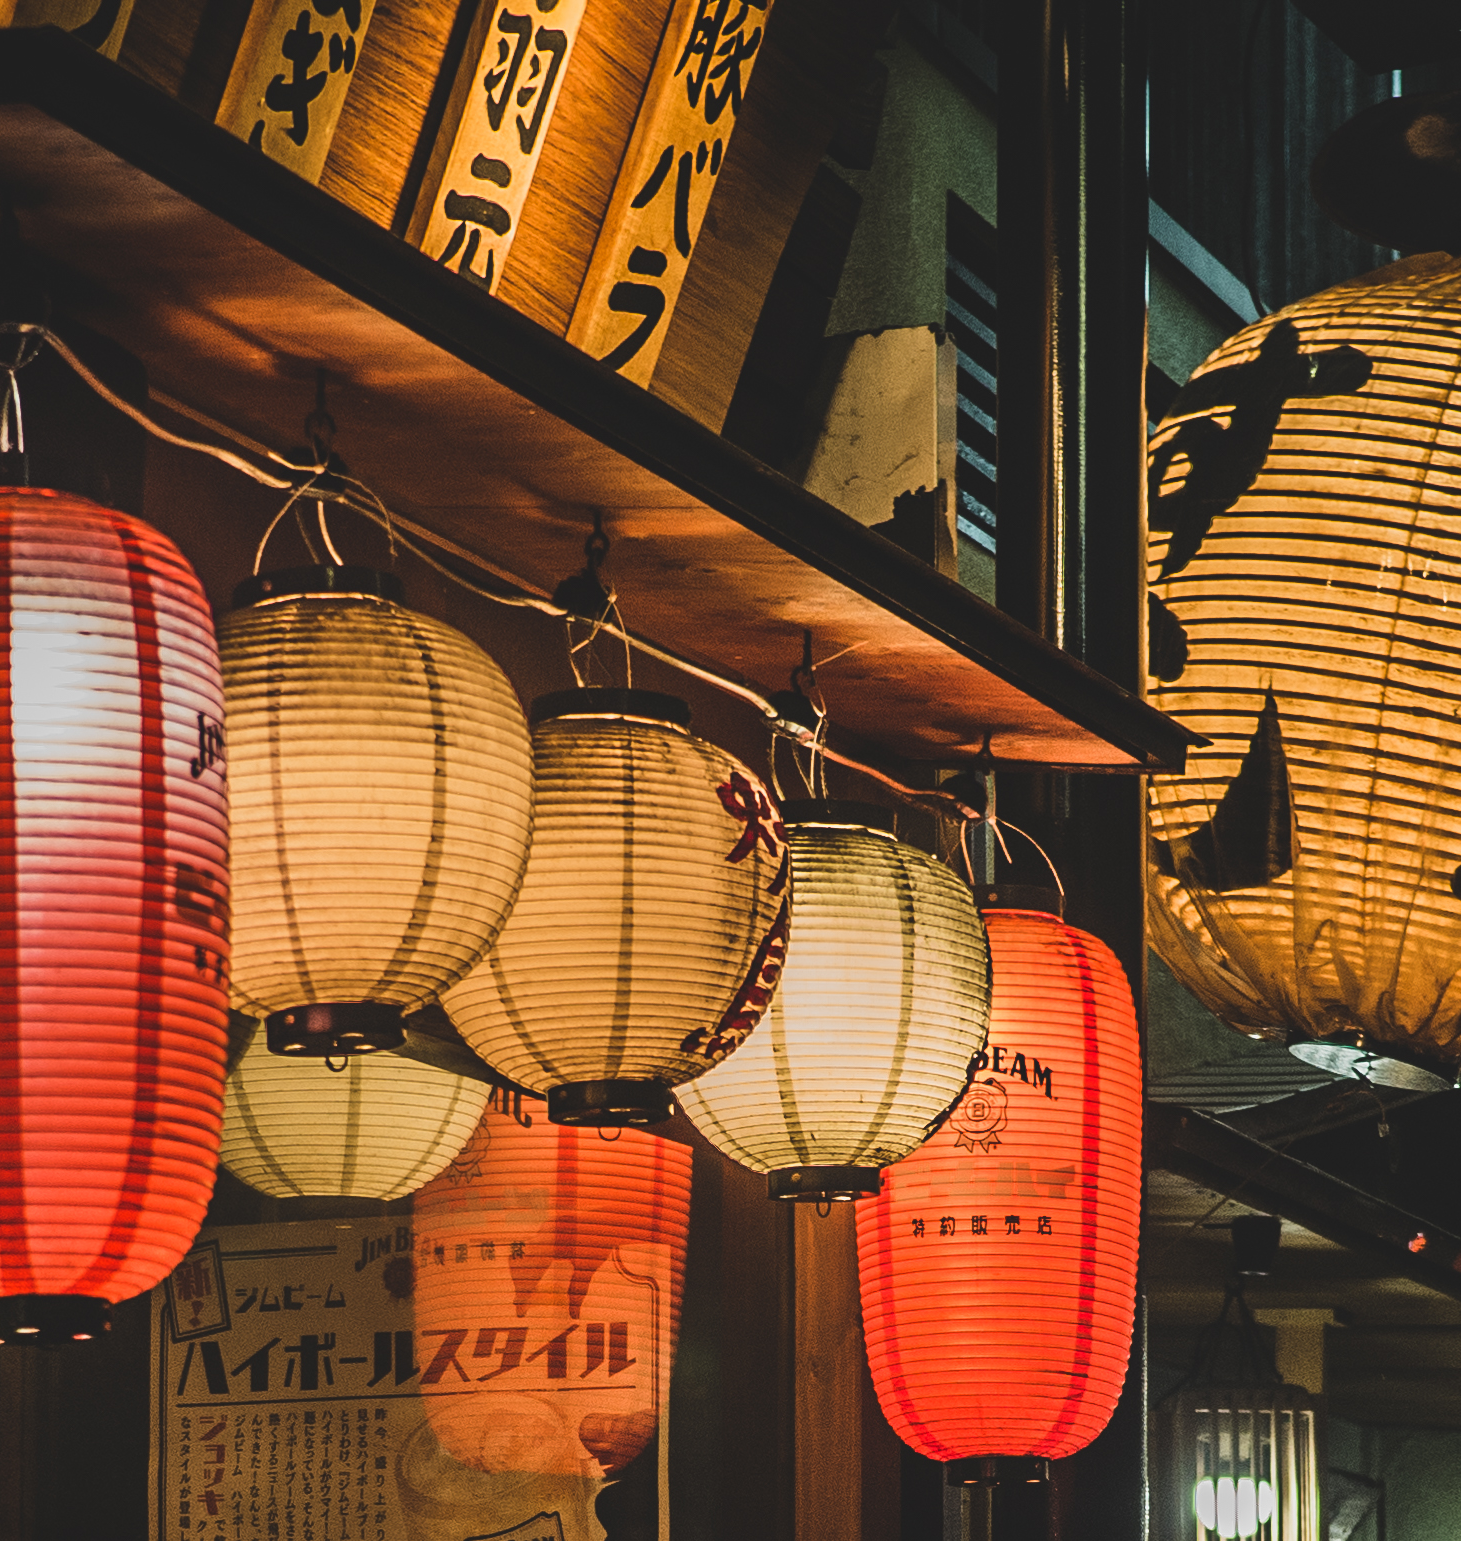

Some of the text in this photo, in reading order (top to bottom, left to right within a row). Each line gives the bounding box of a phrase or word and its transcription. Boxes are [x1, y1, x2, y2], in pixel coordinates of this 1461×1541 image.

[437, 0, 568, 297] 羽元
[911, 1214, 1053, 1239] 特約販売店
[354, 1236, 391, 1272] JIM
[233, 1283, 347, 1315] ジムビーム
[176, 1320, 638, 1397] ハイボールスタイル
